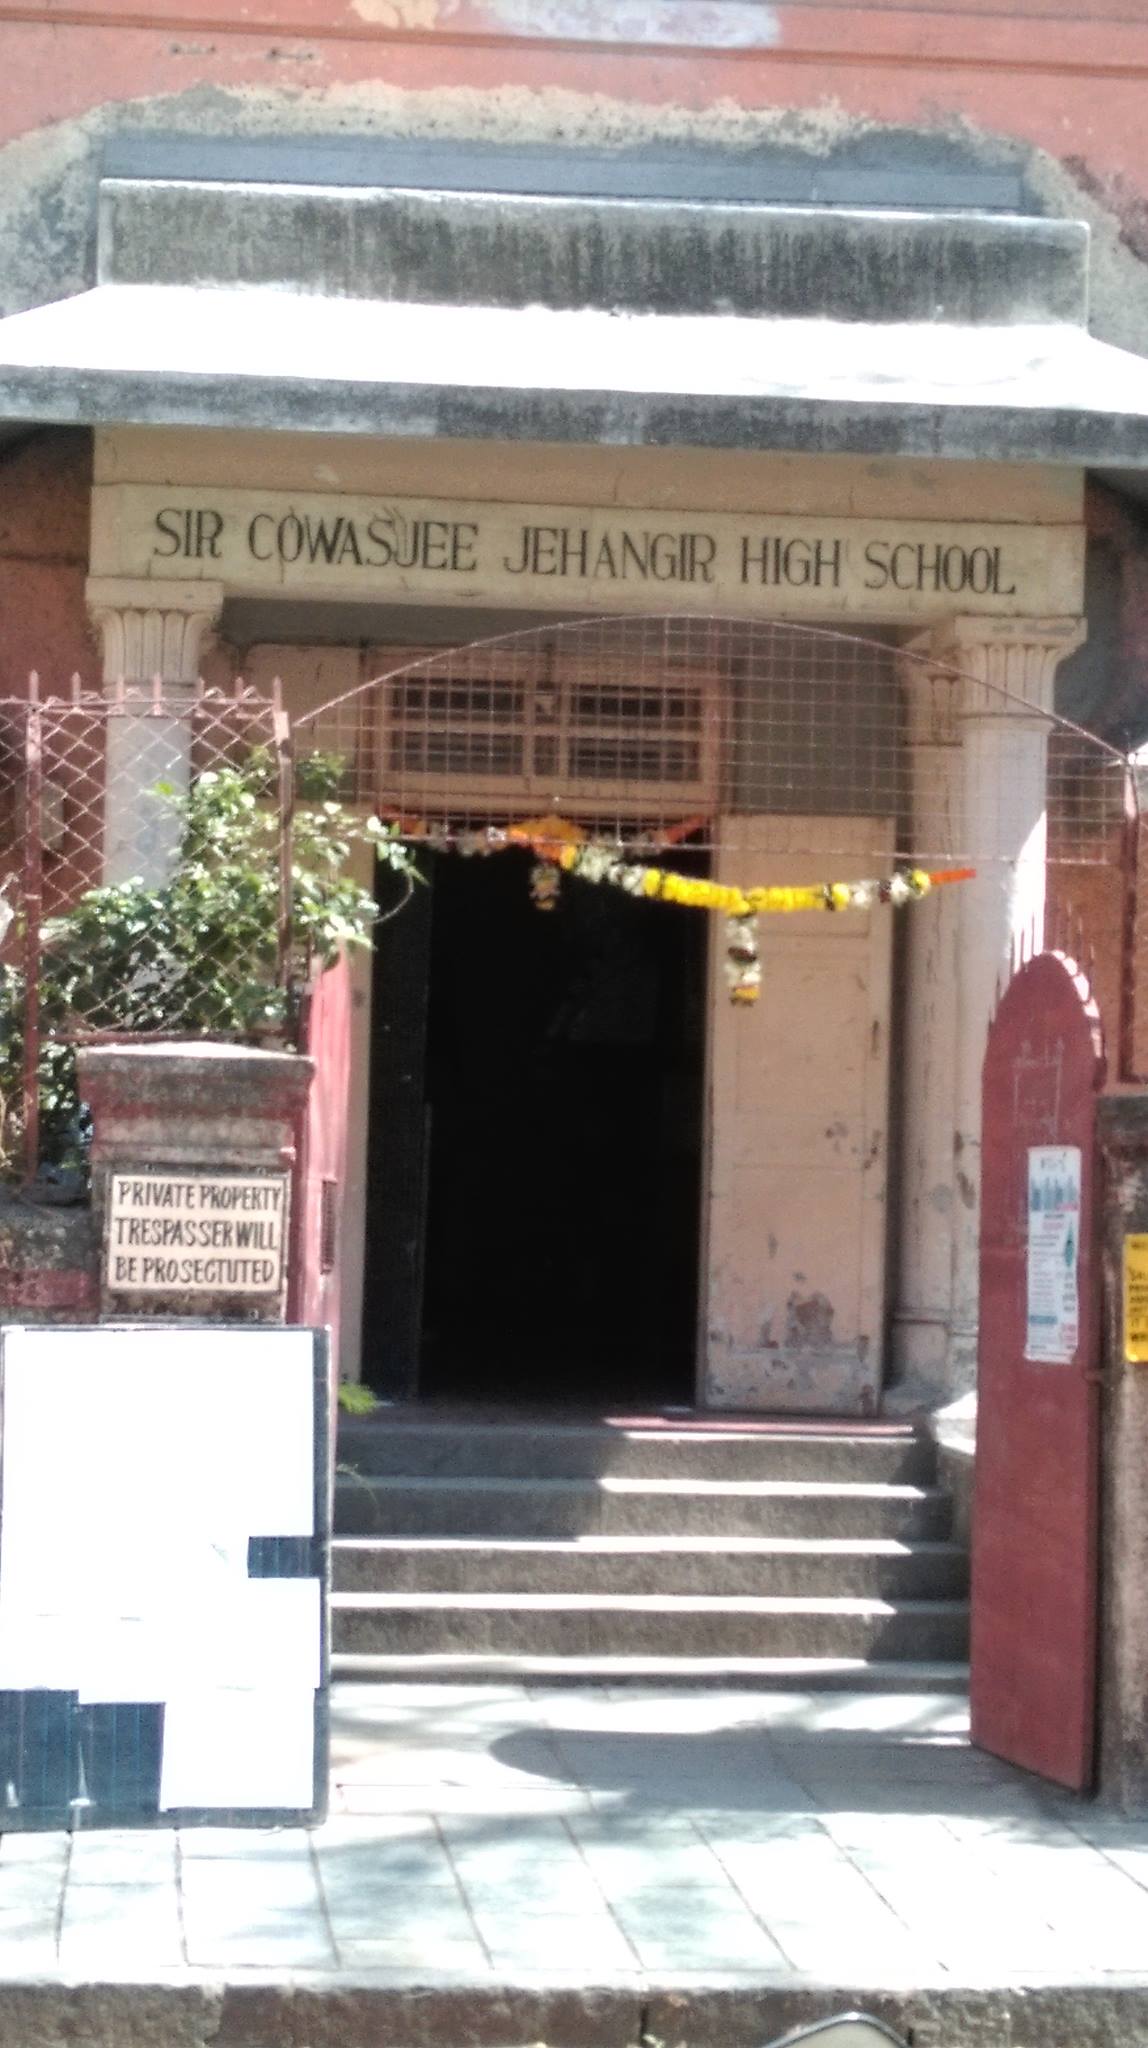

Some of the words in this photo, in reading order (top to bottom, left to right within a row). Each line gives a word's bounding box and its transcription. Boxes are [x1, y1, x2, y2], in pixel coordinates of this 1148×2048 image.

[153, 508, 224, 560] SIR
[248, 513, 478, 571] COWASJEE
[503, 526, 717, 583] JEHANGIR
[742, 536, 841, 588] HIGH
[864, 541, 1017, 595] SCHOOL
[118, 1181, 195, 1209] PRIVATE
[199, 1185, 282, 1211] PROPERTY
[115, 1217, 233, 1247] TRESPASSER
[237, 1221, 278, 1250] WILL
[115, 1256, 137, 1282] BE
